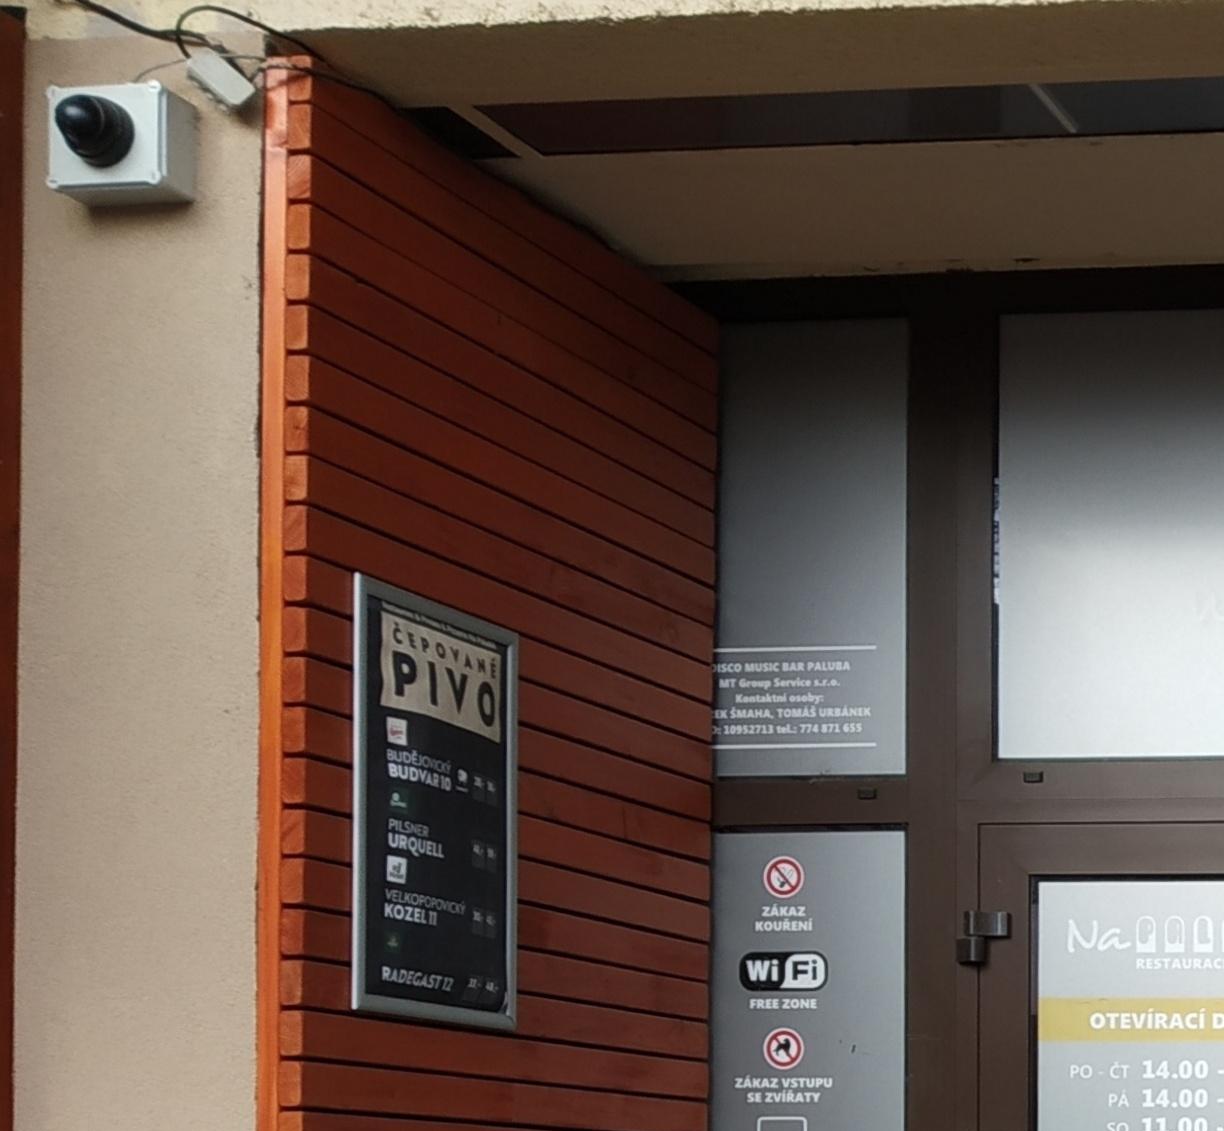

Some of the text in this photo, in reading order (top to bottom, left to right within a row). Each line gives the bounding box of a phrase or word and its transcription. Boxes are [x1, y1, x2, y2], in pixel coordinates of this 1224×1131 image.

[392, 622, 497, 680] ČEPOVANÉ
[744, 662, 780, 673] MUSIC
[782, 662, 805, 672] BAR
[807, 661, 851, 672] PALUBA
[391, 650, 496, 727] PIVO
[718, 677, 840, 690] MT Group Service s.r.o.
[789, 692, 824, 705] osoby:
[776, 704, 816, 718] TOMÁŠ
[818, 704, 871, 718] URBÁNEK
[723, 724, 774, 735] 10952713
[799, 723, 819, 734] 774
[821, 723, 840, 734] 871
[843, 722, 863, 733] 655
[387, 762, 440, 788] BUDVAR
[439, 775, 452, 791] 10
[387, 817, 430, 838] PILSNER
[387, 832, 445, 859] URQUELL
[384, 902, 428, 925] KOZEL
[761, 904, 806, 917] ZÁKAZ
[754, 918, 814, 932] KOUŘENÍ
[1067, 918, 1131, 953] Na
[381, 965, 444, 991] RADEGAST
[749, 998, 818, 1010] FREE ZONE
[1089, 1008, 1206, 1030] OTEVÍRACÍ
[1069, 1065, 1093, 1079] PO
[1109, 1062, 1131, 1079] ČT
[1141, 1060, 1209, 1080] 14.00
[734, 1075, 834, 1089] ZÁKAZ VSTUPU
[746, 1089, 822, 1104] SE ZVÍŘATY
[1108, 1090, 1130, 1108] PÁ
[1141, 1088, 1209, 1109] 14.00
